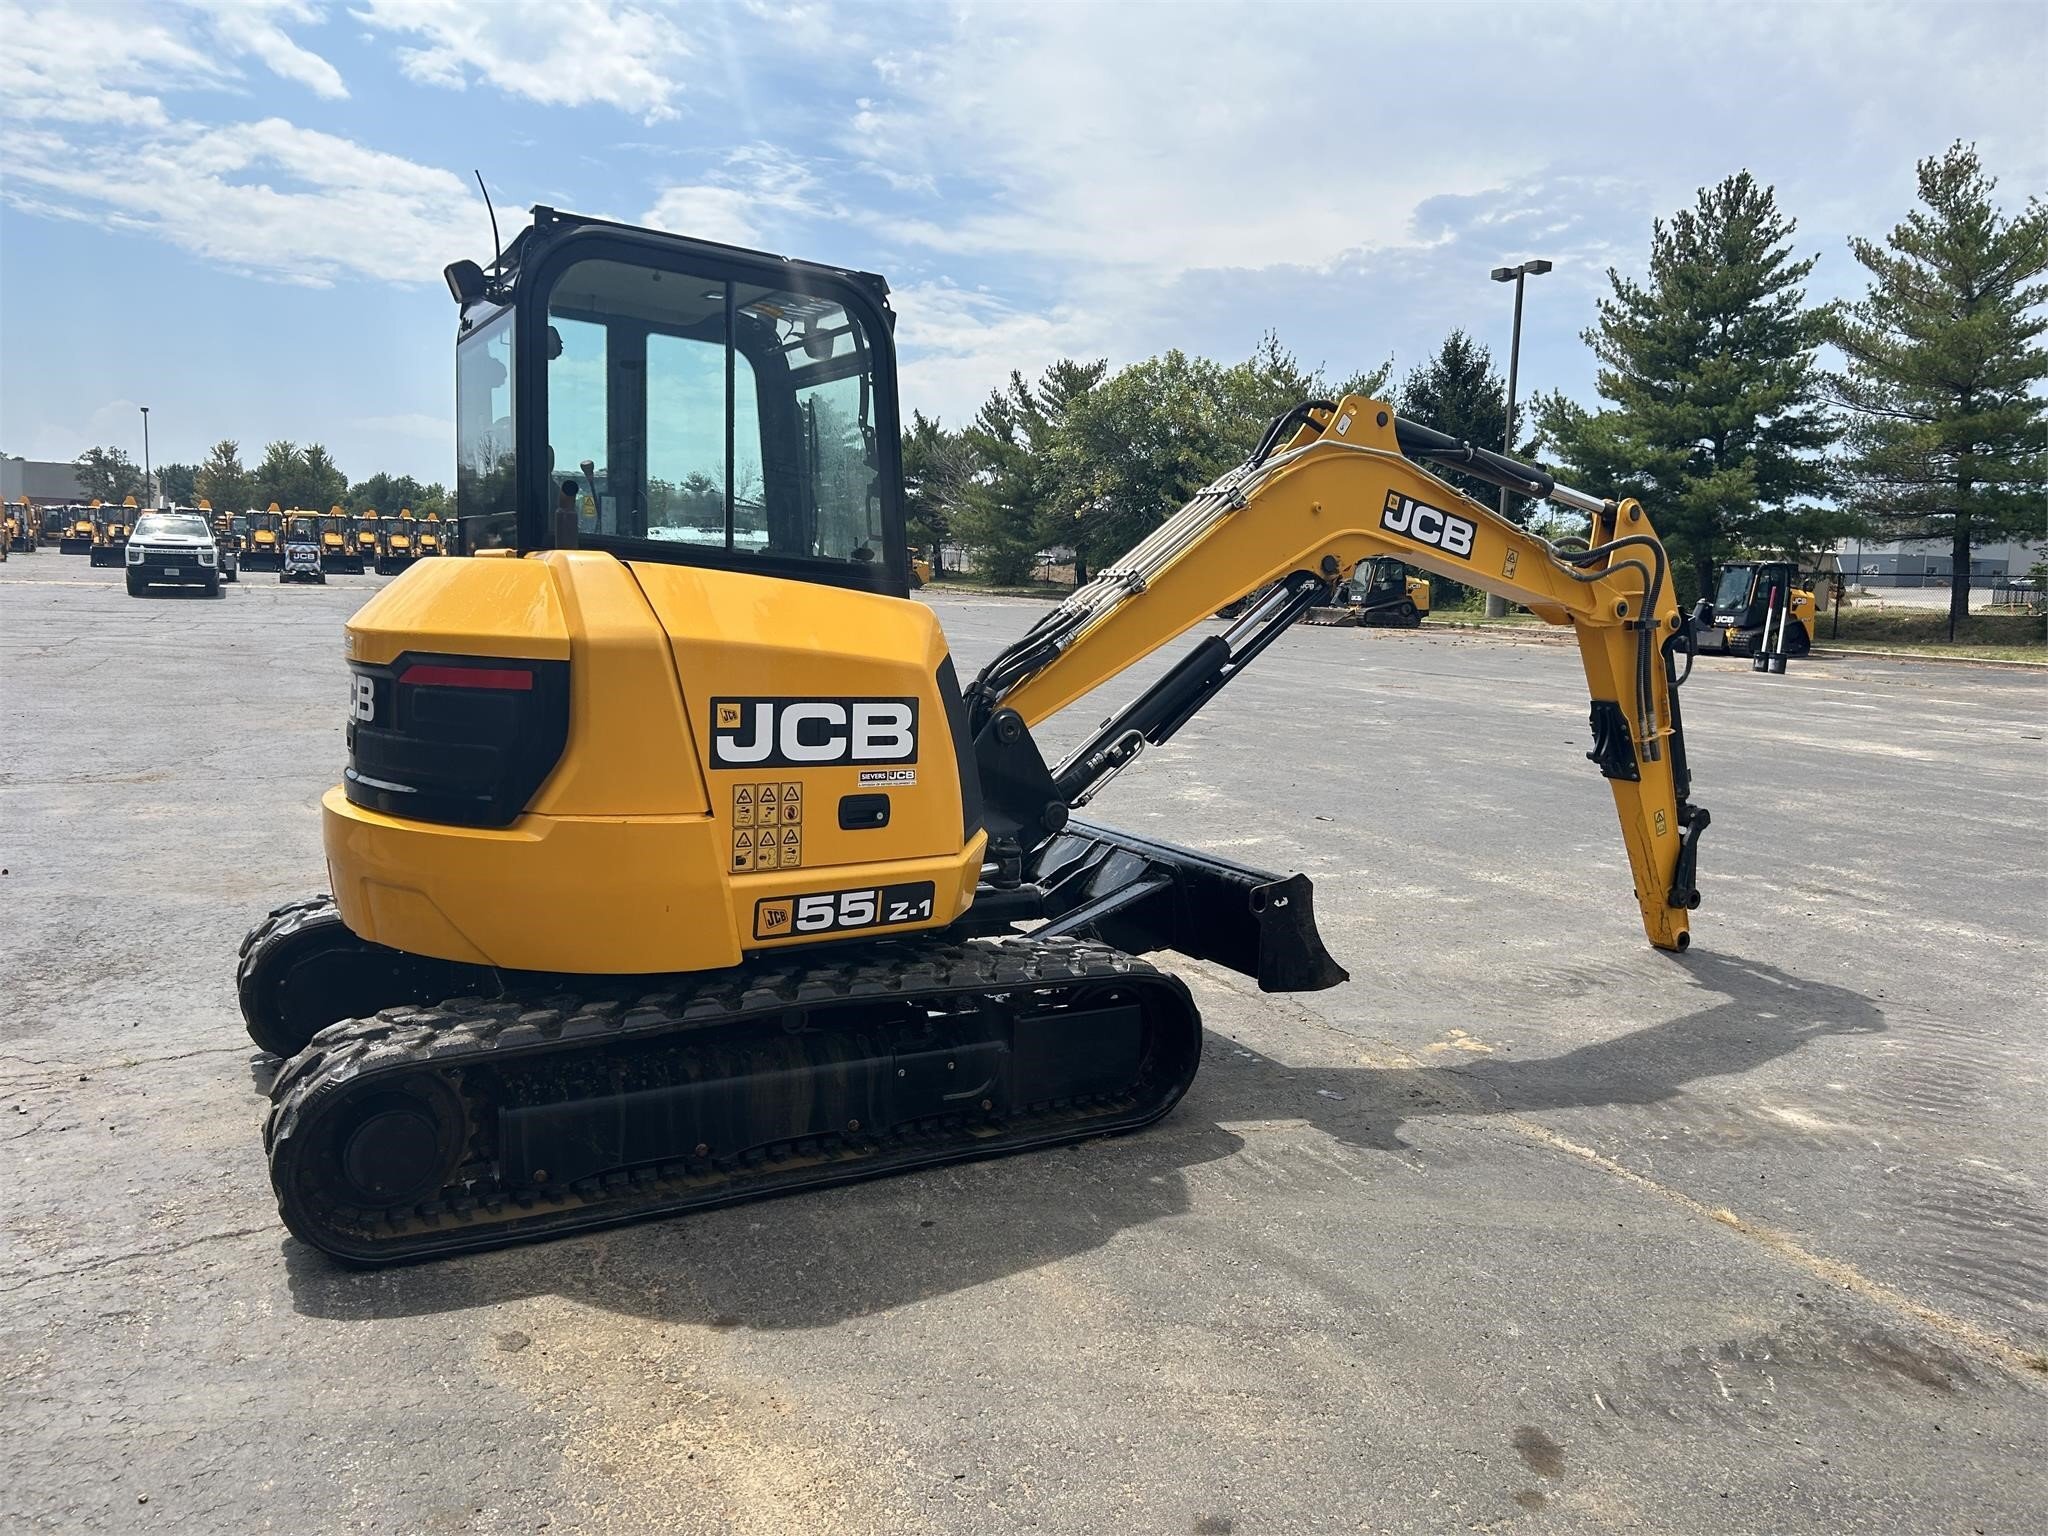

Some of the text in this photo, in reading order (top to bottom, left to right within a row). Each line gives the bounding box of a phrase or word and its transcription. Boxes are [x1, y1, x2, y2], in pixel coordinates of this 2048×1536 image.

[1384, 499, 1473, 555] JCB
[1714, 615, 1735, 623] JCB
[349, 672, 375, 722] CB
[723, 709, 739, 721] JCB
[716, 703, 914, 763] JCB
[889, 771, 915, 780] JCB
[766, 910, 788, 928] JCB
[796, 890, 931, 931] 55 Z-1
